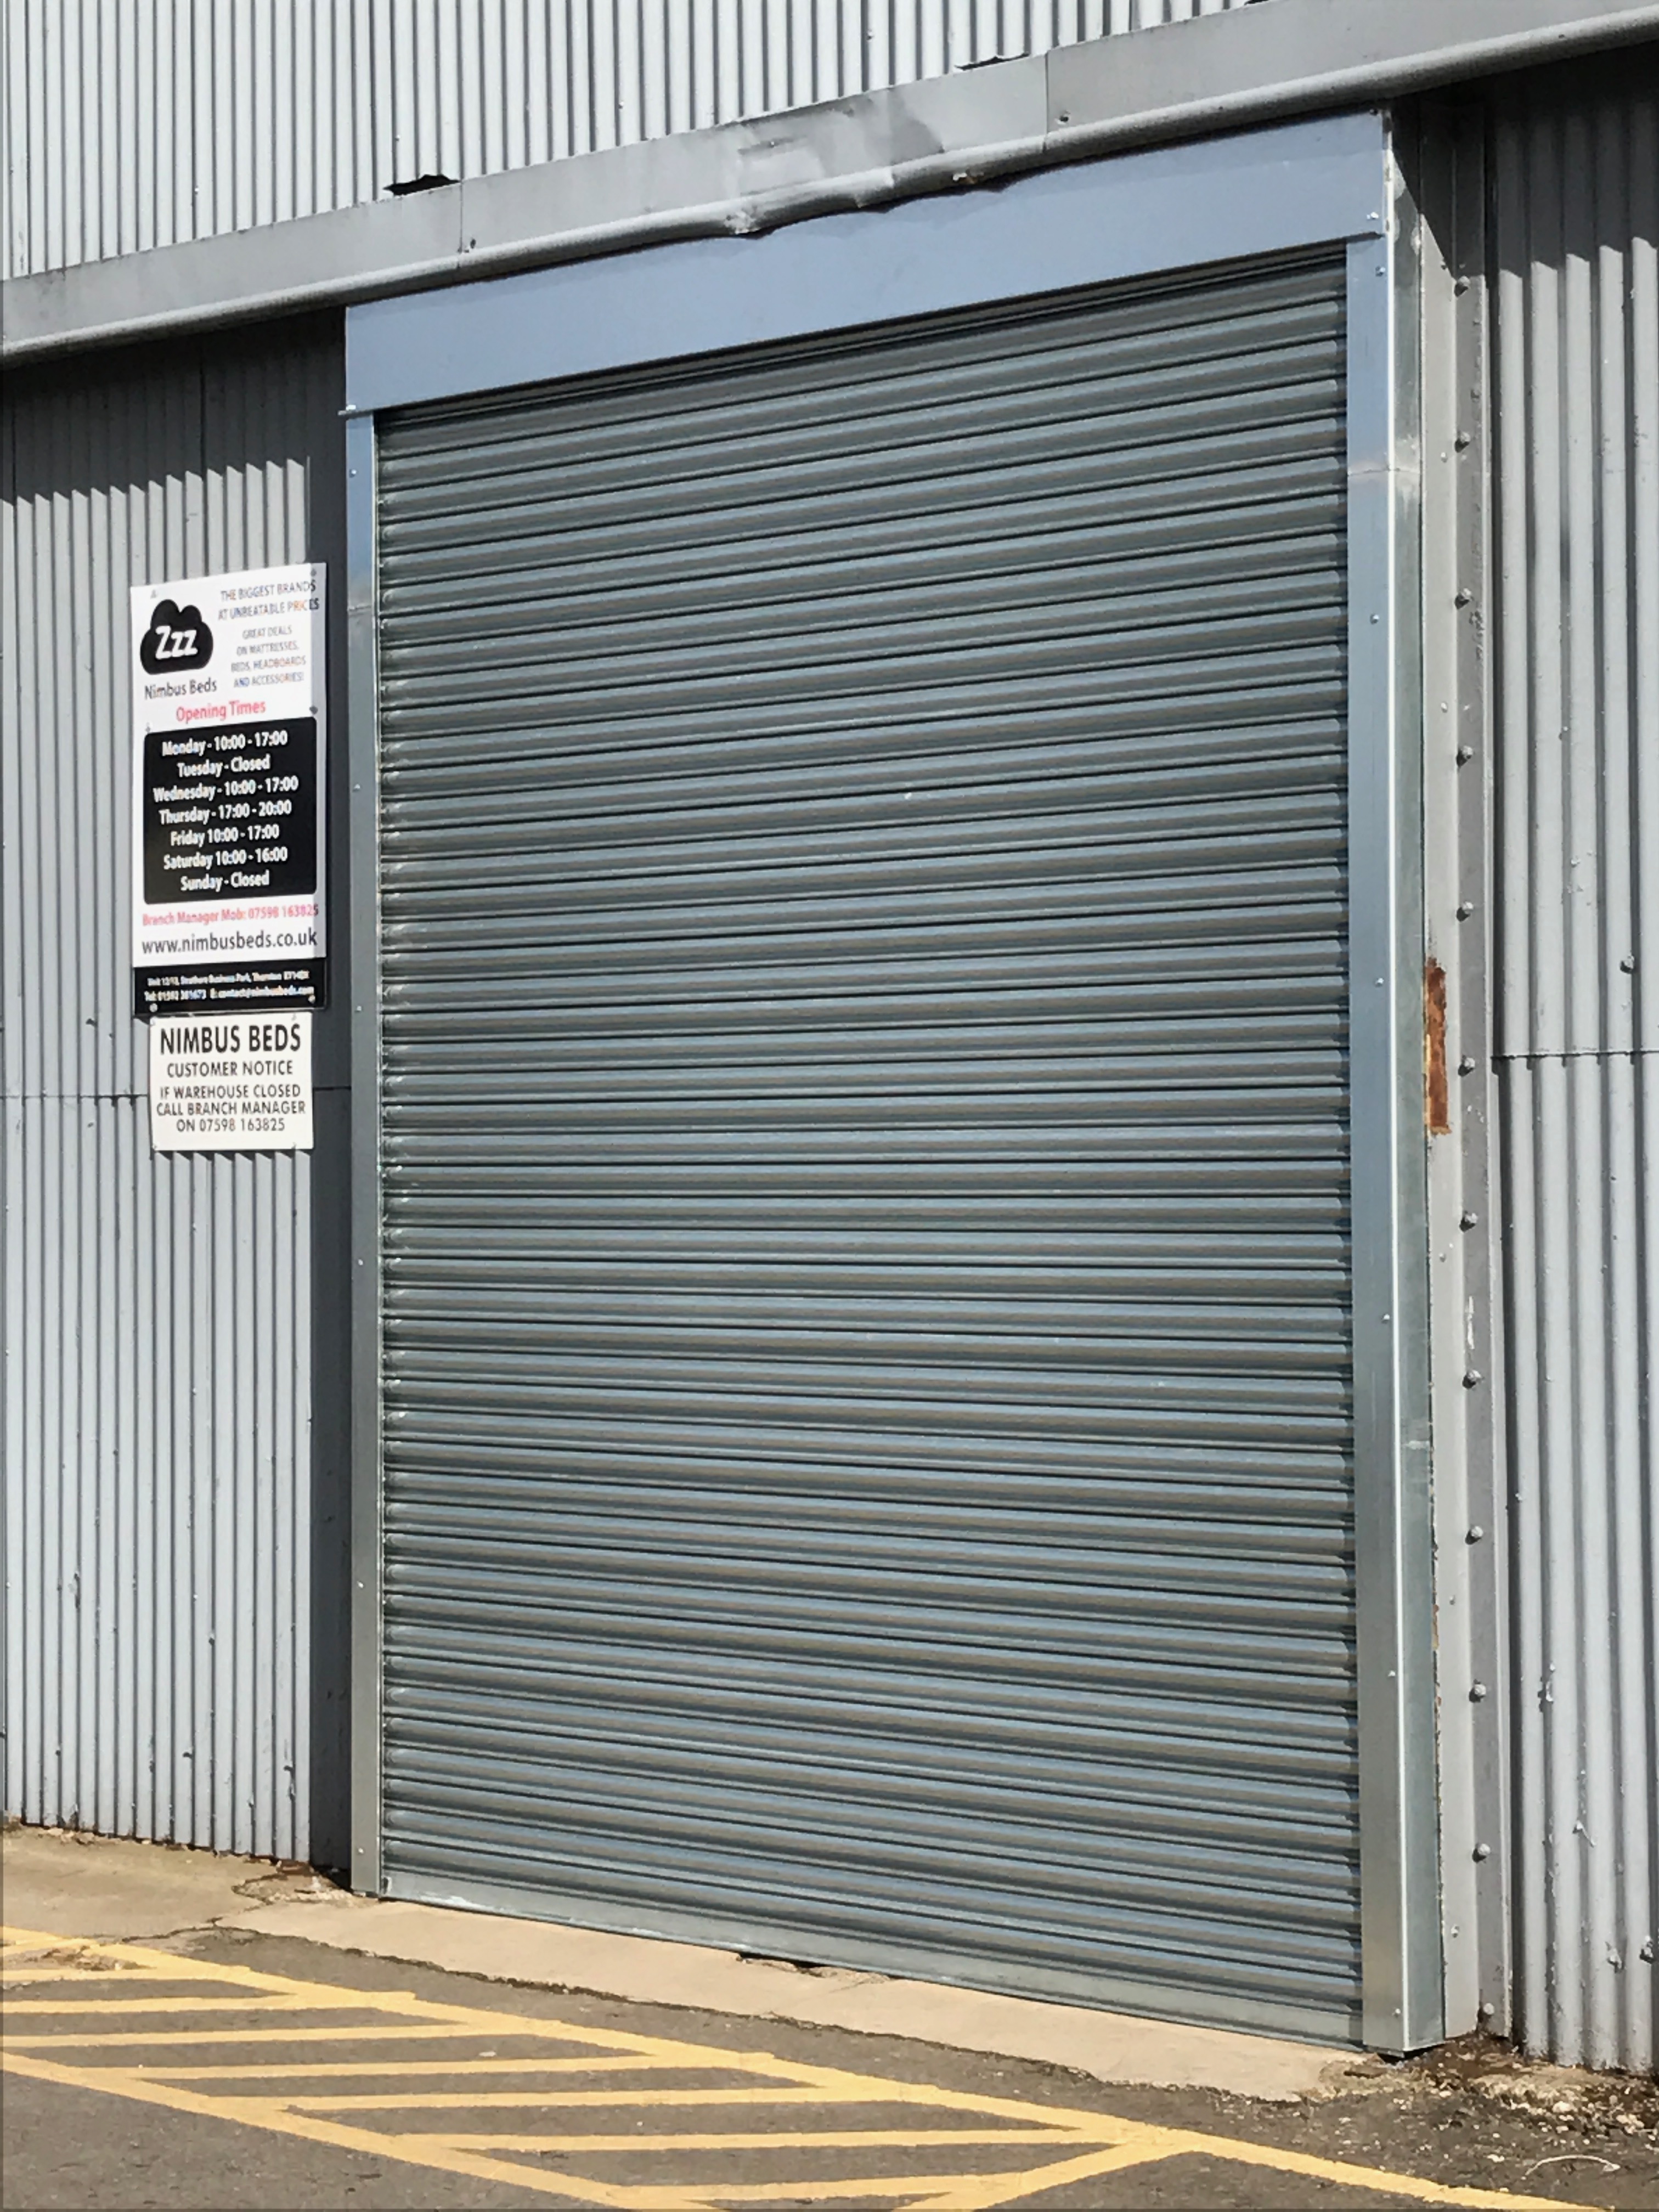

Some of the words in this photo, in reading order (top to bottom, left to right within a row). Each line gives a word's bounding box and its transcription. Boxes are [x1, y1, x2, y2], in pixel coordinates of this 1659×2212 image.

[221, 589, 236, 602] THE
[238, 584, 274, 600] BIGGEST
[276, 579, 316, 595] BRANDS
[218, 608, 228, 620] AT
[229, 602, 285, 619] UNBEATABLE
[287, 597, 320, 612] PRICES
[242, 627, 265, 639] GREAT
[267, 624, 292, 637] DEALS
[236, 646, 247, 656] ON
[253, 655, 306, 670] HEADBOARDS
[145, 681, 187, 699] Nimbus
[189, 677, 217, 695] Beds
[233, 676, 250, 688] AND
[176, 703, 227, 724] Opening
[228, 700, 267, 716] Times
[161, 738, 206, 757] Monday
[214, 733, 246, 752] 10:00
[255, 730, 289, 747] 17:00
[177, 759, 223, 777] Tuesday
[230, 754, 271, 772] Closed
[153, 783, 216, 802] Wednesday
[224, 779, 257, 796] 10:00
[264, 775, 299, 792] 17:00
[159, 806, 210, 825] Thursday
[218, 803, 250, 820] 17:00
[258, 799, 292, 816] 20:00
[170, 830, 205, 848] Friday
[207, 827, 239, 843] 10:00
[247, 823, 280, 840] 17:00
[163, 851, 214, 870] Saturday
[215, 849, 247, 866] 10:00
[255, 846, 289, 863] 16:00
[180, 873, 223, 892] Sunday
[230, 870, 270, 888] Closed
[142, 912, 175, 927] Branch
[177, 910, 219, 926] Manager
[221, 907, 246, 921] Mob:
[248, 906, 279, 919] 07598
[282, 903, 319, 917] 163825
[142, 926, 318, 954] www.nimbusbeds.co.uk
[160, 1024, 241, 1055] NIMBUS
[249, 1023, 301, 1052] BEDS
[167, 1061, 238, 1078] CUSTOMER
[242, 1059, 294, 1076] NOTICE
[160, 1086, 170, 1099] IF
[173, 1085, 249, 1099] WAREHOUSE
[253, 1084, 301, 1098] CLOSED
[156, 1102, 183, 1116] CALL
[187, 1102, 238, 1115] BRANCH
[241, 1100, 307, 1115] MANAGER
[176, 1119, 196, 1132] ON
[199, 1118, 236, 1132] 07598
[240, 1117, 285, 1131] 163825
